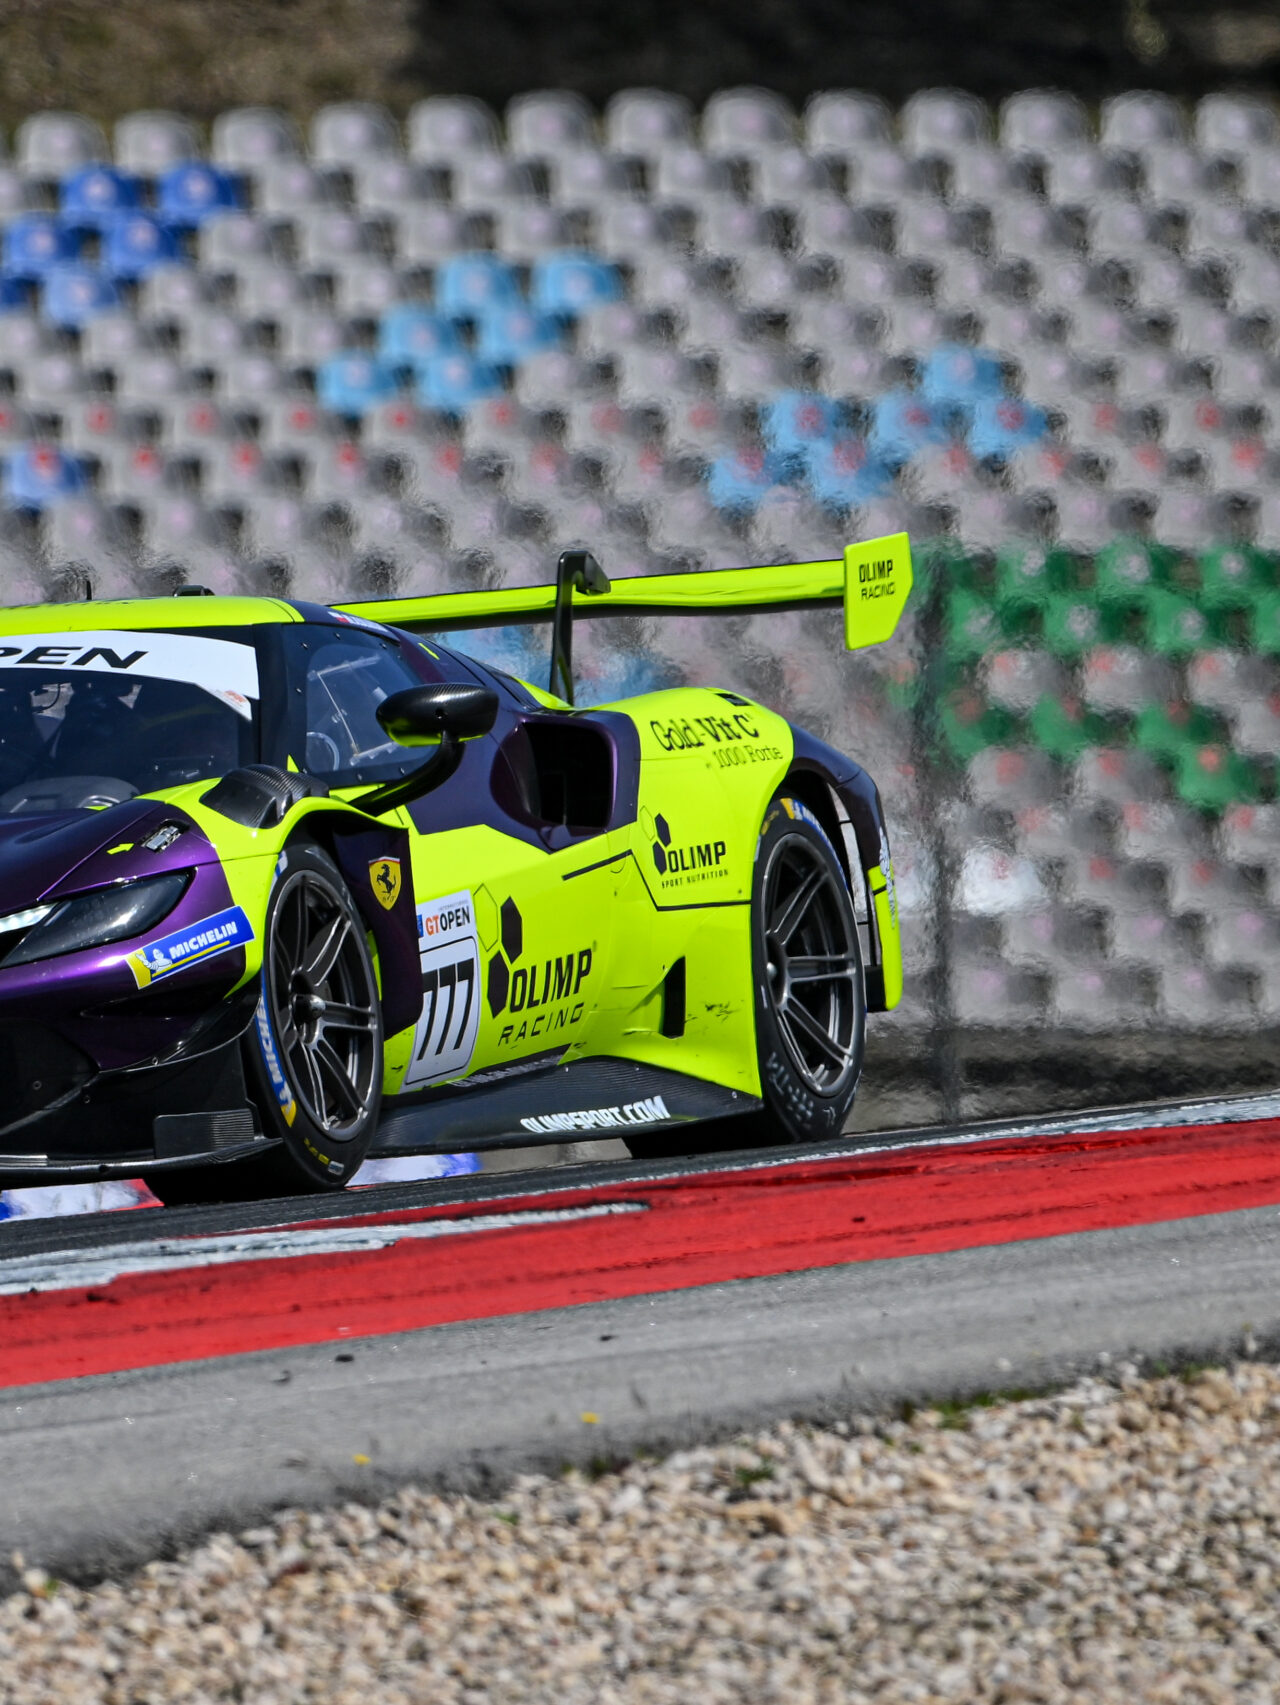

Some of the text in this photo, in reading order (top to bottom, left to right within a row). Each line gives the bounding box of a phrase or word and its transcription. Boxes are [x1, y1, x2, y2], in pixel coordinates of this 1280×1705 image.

[859, 559, 893, 583] OLIMP
[861, 582, 895, 600] RACING
[733, 714, 759, 738] C
[713, 745, 783, 768] 1000 Forte
[668, 841, 727, 873] OLIMP
[662, 869, 728, 889] SPORT NUTRITION
[169, 921, 238, 960] MICHELIN
[509, 948, 592, 1013] OLIMP
[417, 958, 474, 1061] 777
[498, 1002, 585, 1047] RACING
[520, 1095, 671, 1133] OLIMPSPORT.COM
